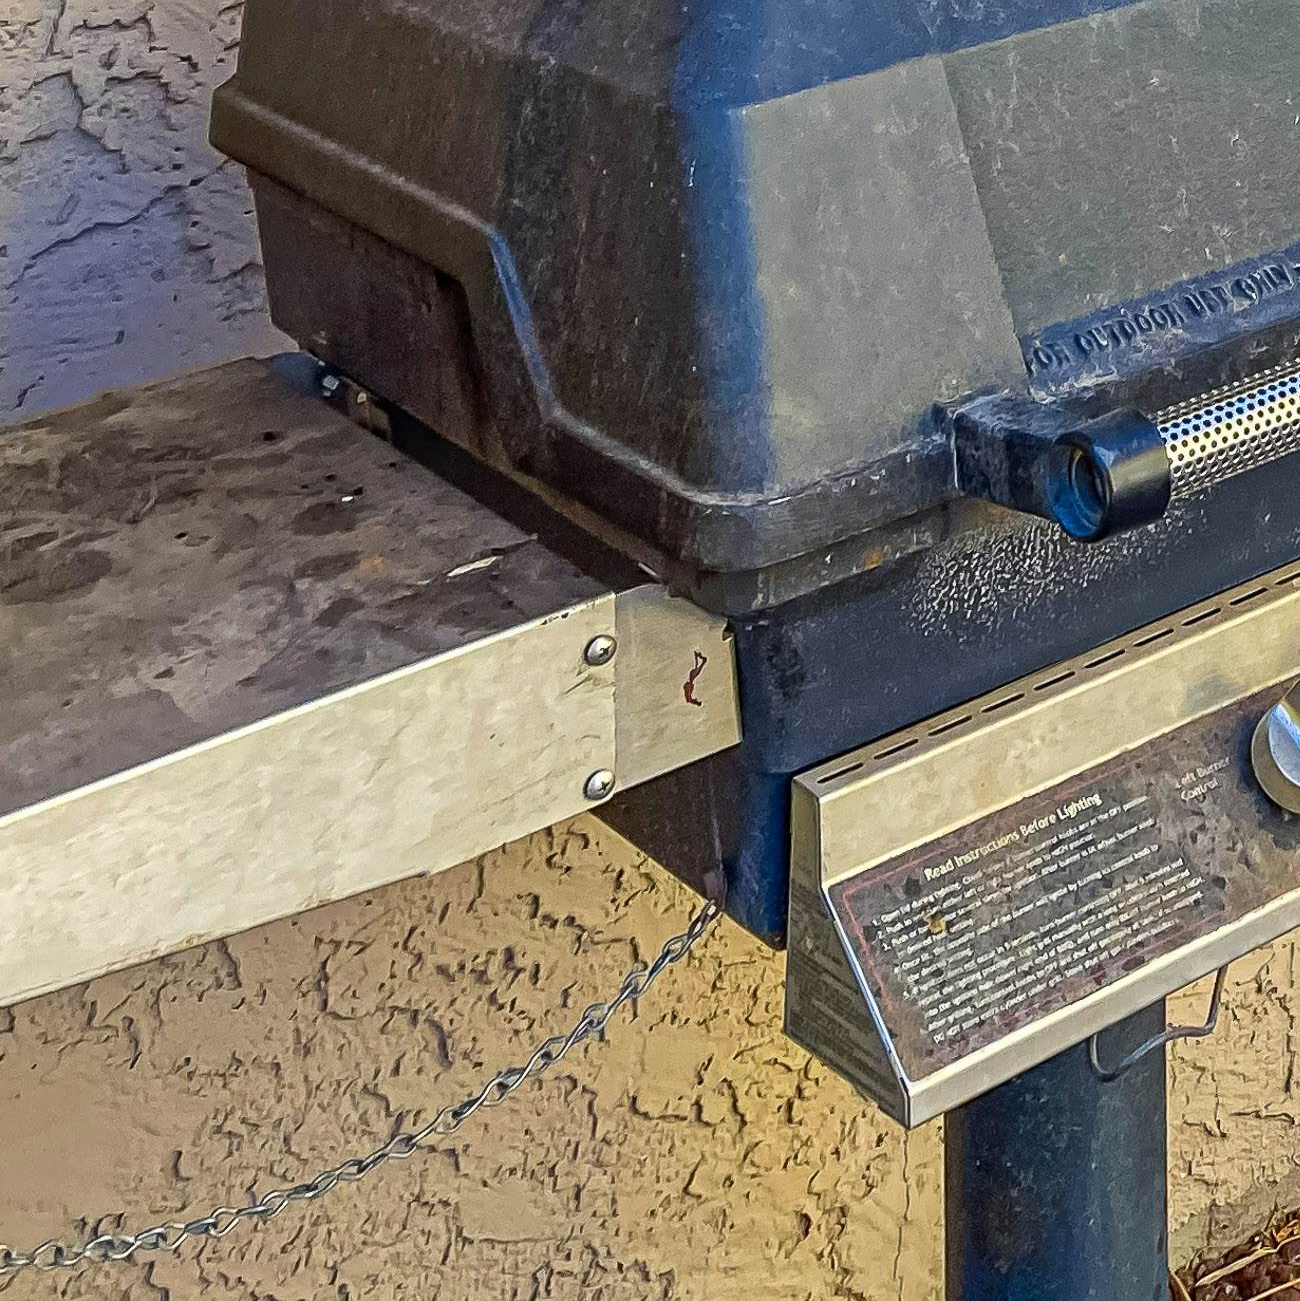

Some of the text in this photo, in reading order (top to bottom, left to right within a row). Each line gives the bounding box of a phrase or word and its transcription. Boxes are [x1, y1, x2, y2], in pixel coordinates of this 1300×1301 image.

[923, 793, 1103, 882] Read Instructions Before Lighting
